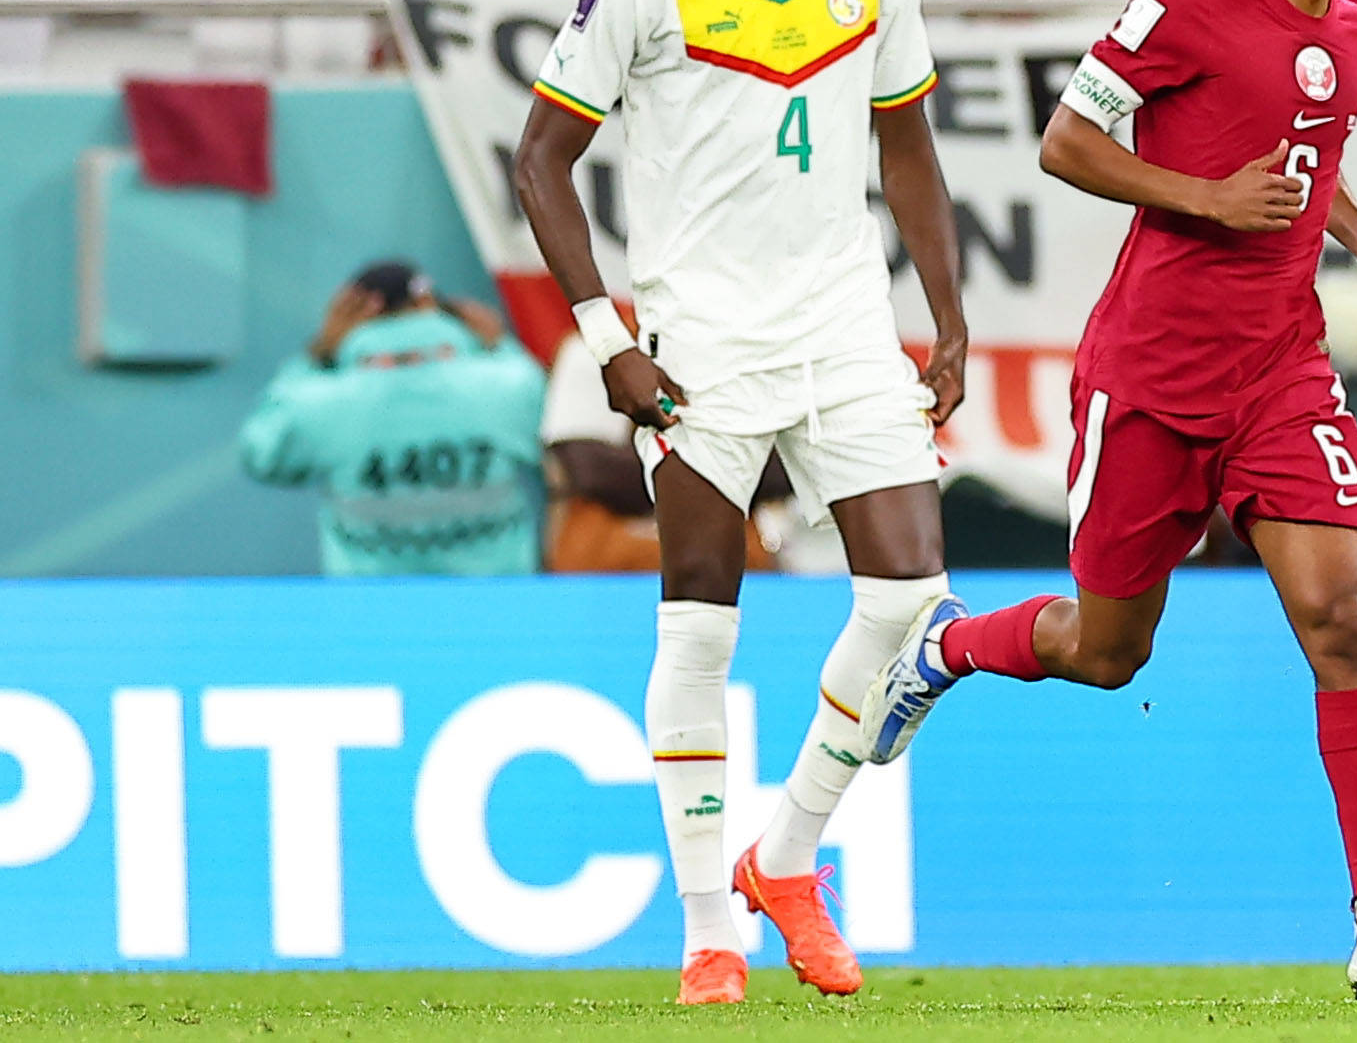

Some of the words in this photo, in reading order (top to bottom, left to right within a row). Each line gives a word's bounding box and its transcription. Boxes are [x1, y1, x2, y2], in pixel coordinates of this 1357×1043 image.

[1102, 85, 1126, 110] THE
[776, 95, 812, 173] 4
[1285, 143, 1319, 212] 6
[358, 440, 494, 494] 4407
